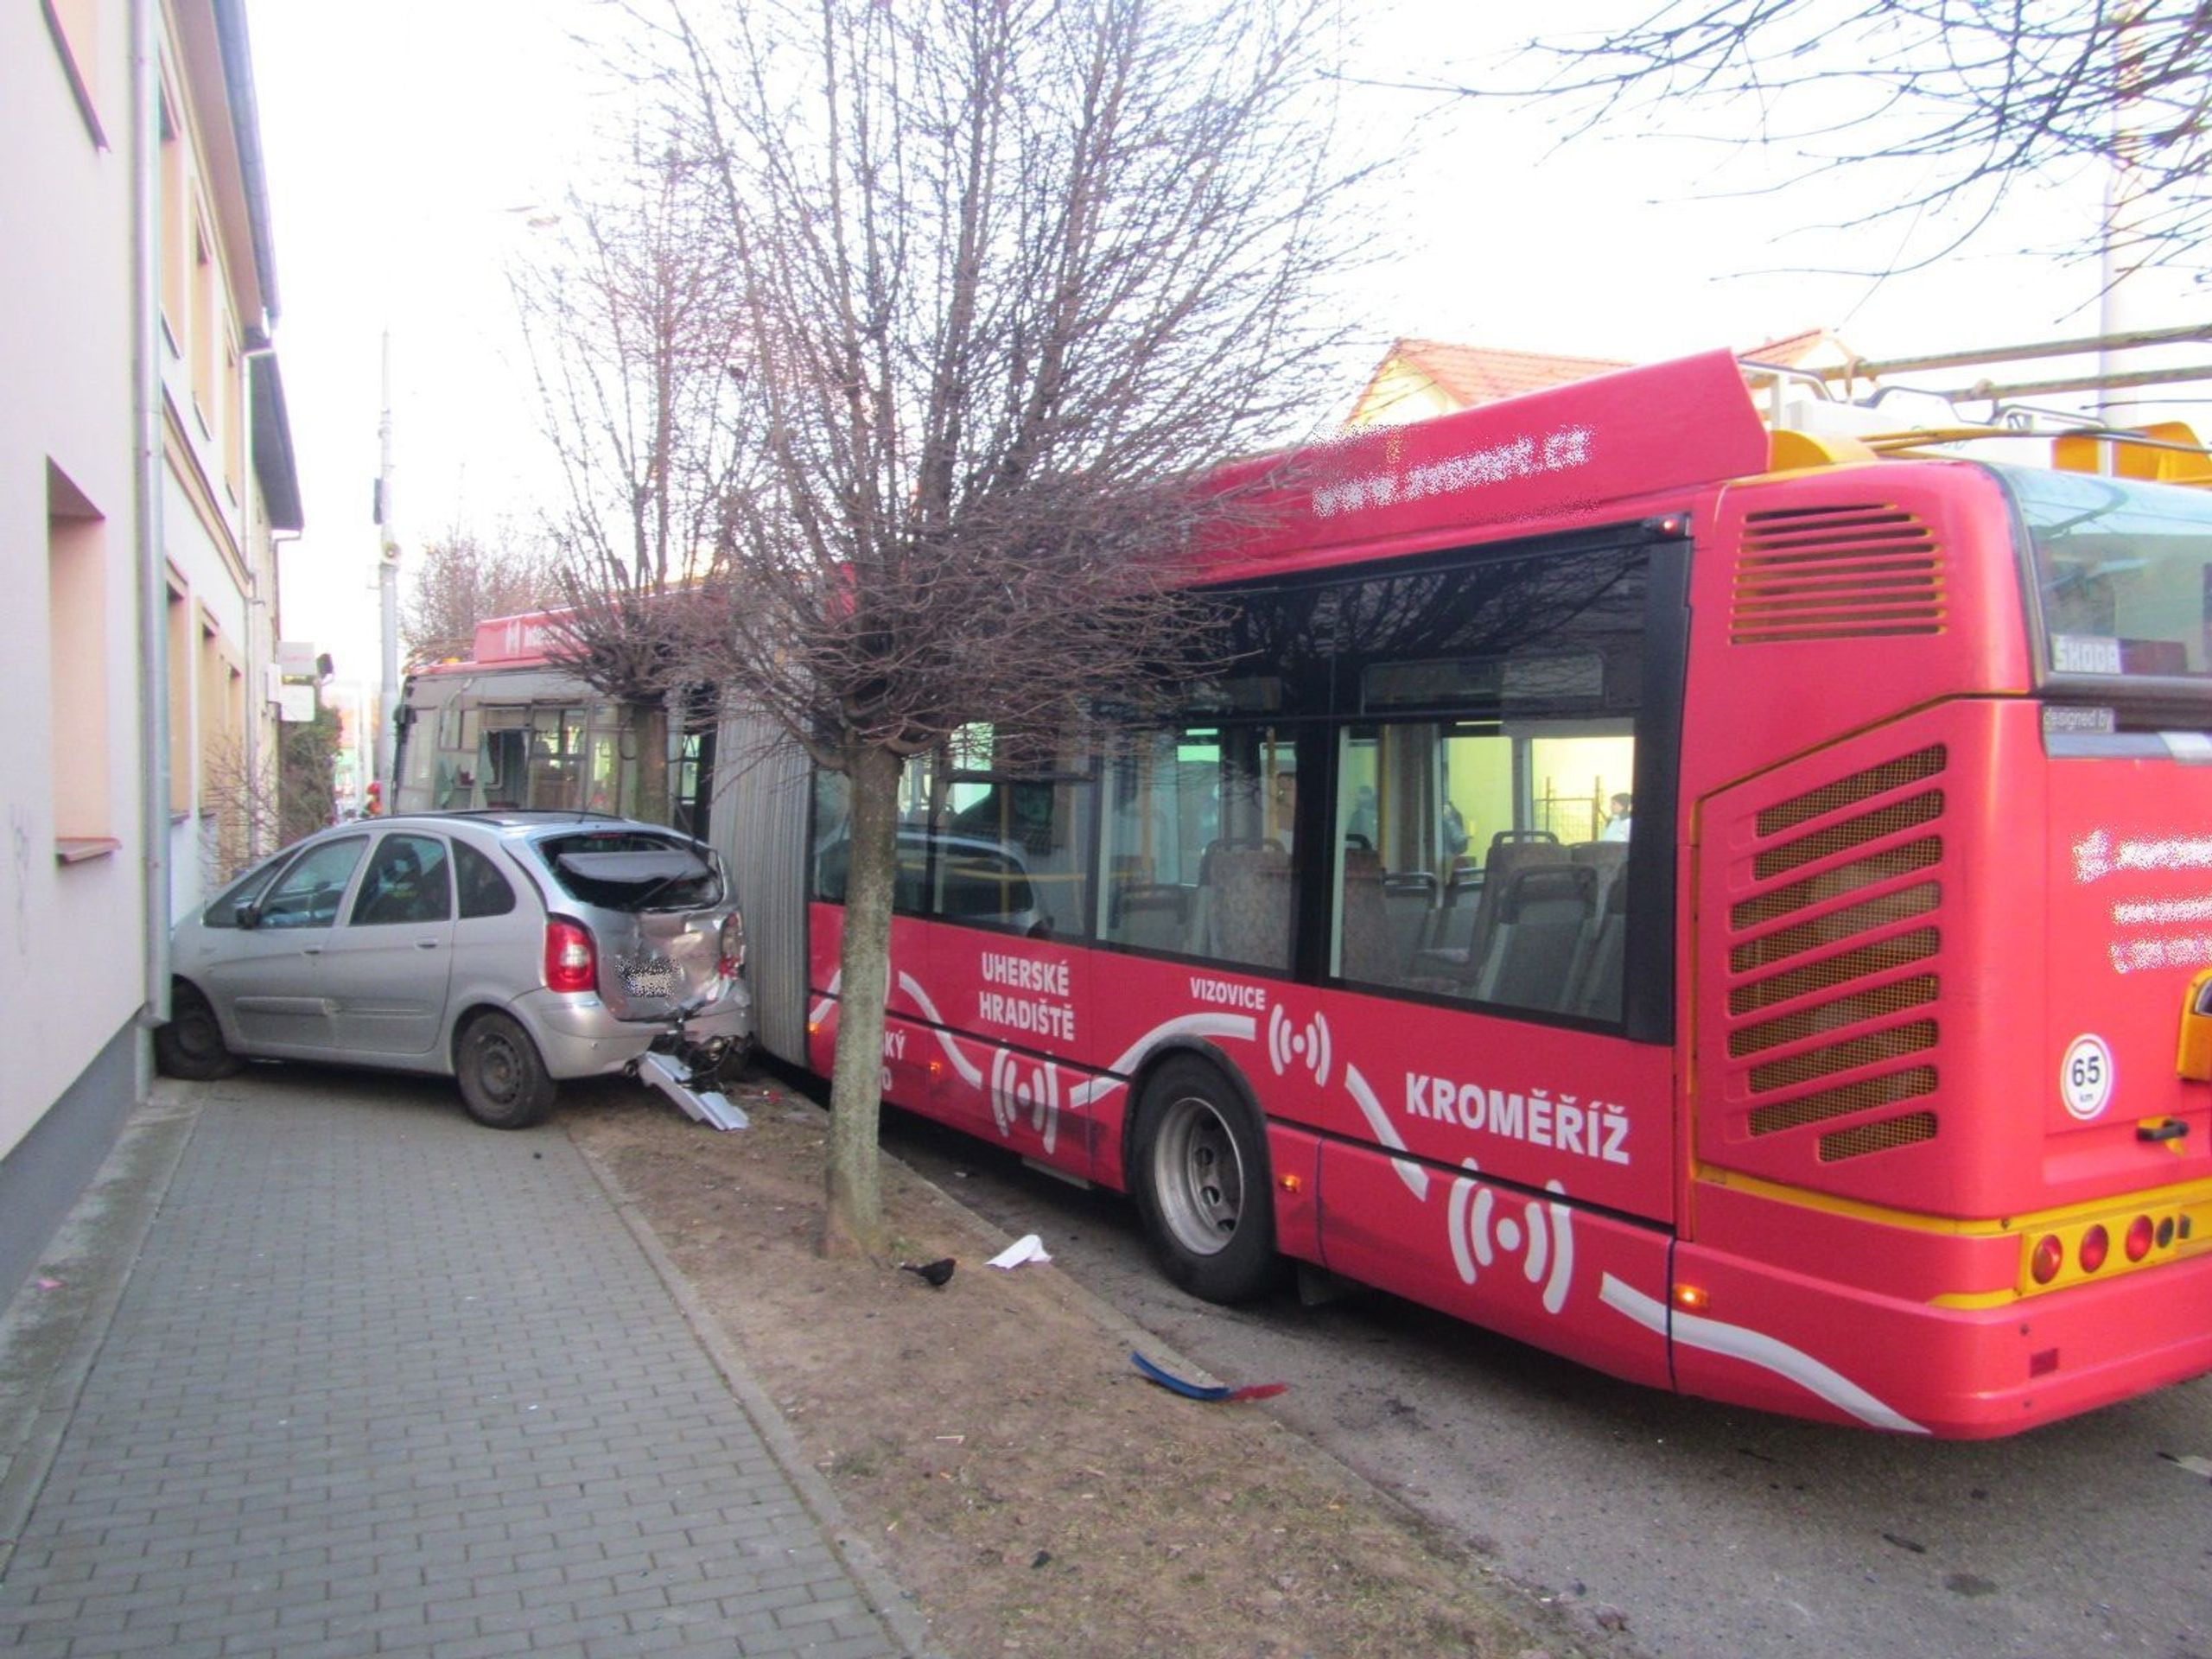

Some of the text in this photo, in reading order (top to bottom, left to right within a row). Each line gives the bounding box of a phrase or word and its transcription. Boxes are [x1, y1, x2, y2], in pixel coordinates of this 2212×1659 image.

[2044, 709, 2114, 733] designed by
[982, 951, 1070, 996] UHERSKÉ
[1190, 977, 1266, 1011] VIZOVICE
[979, 991, 1075, 1041] HRADIŠTĚ
[2072, 1056, 2100, 1087] 65
[1406, 1072, 1630, 1165] KROMĚŘÍŽ
